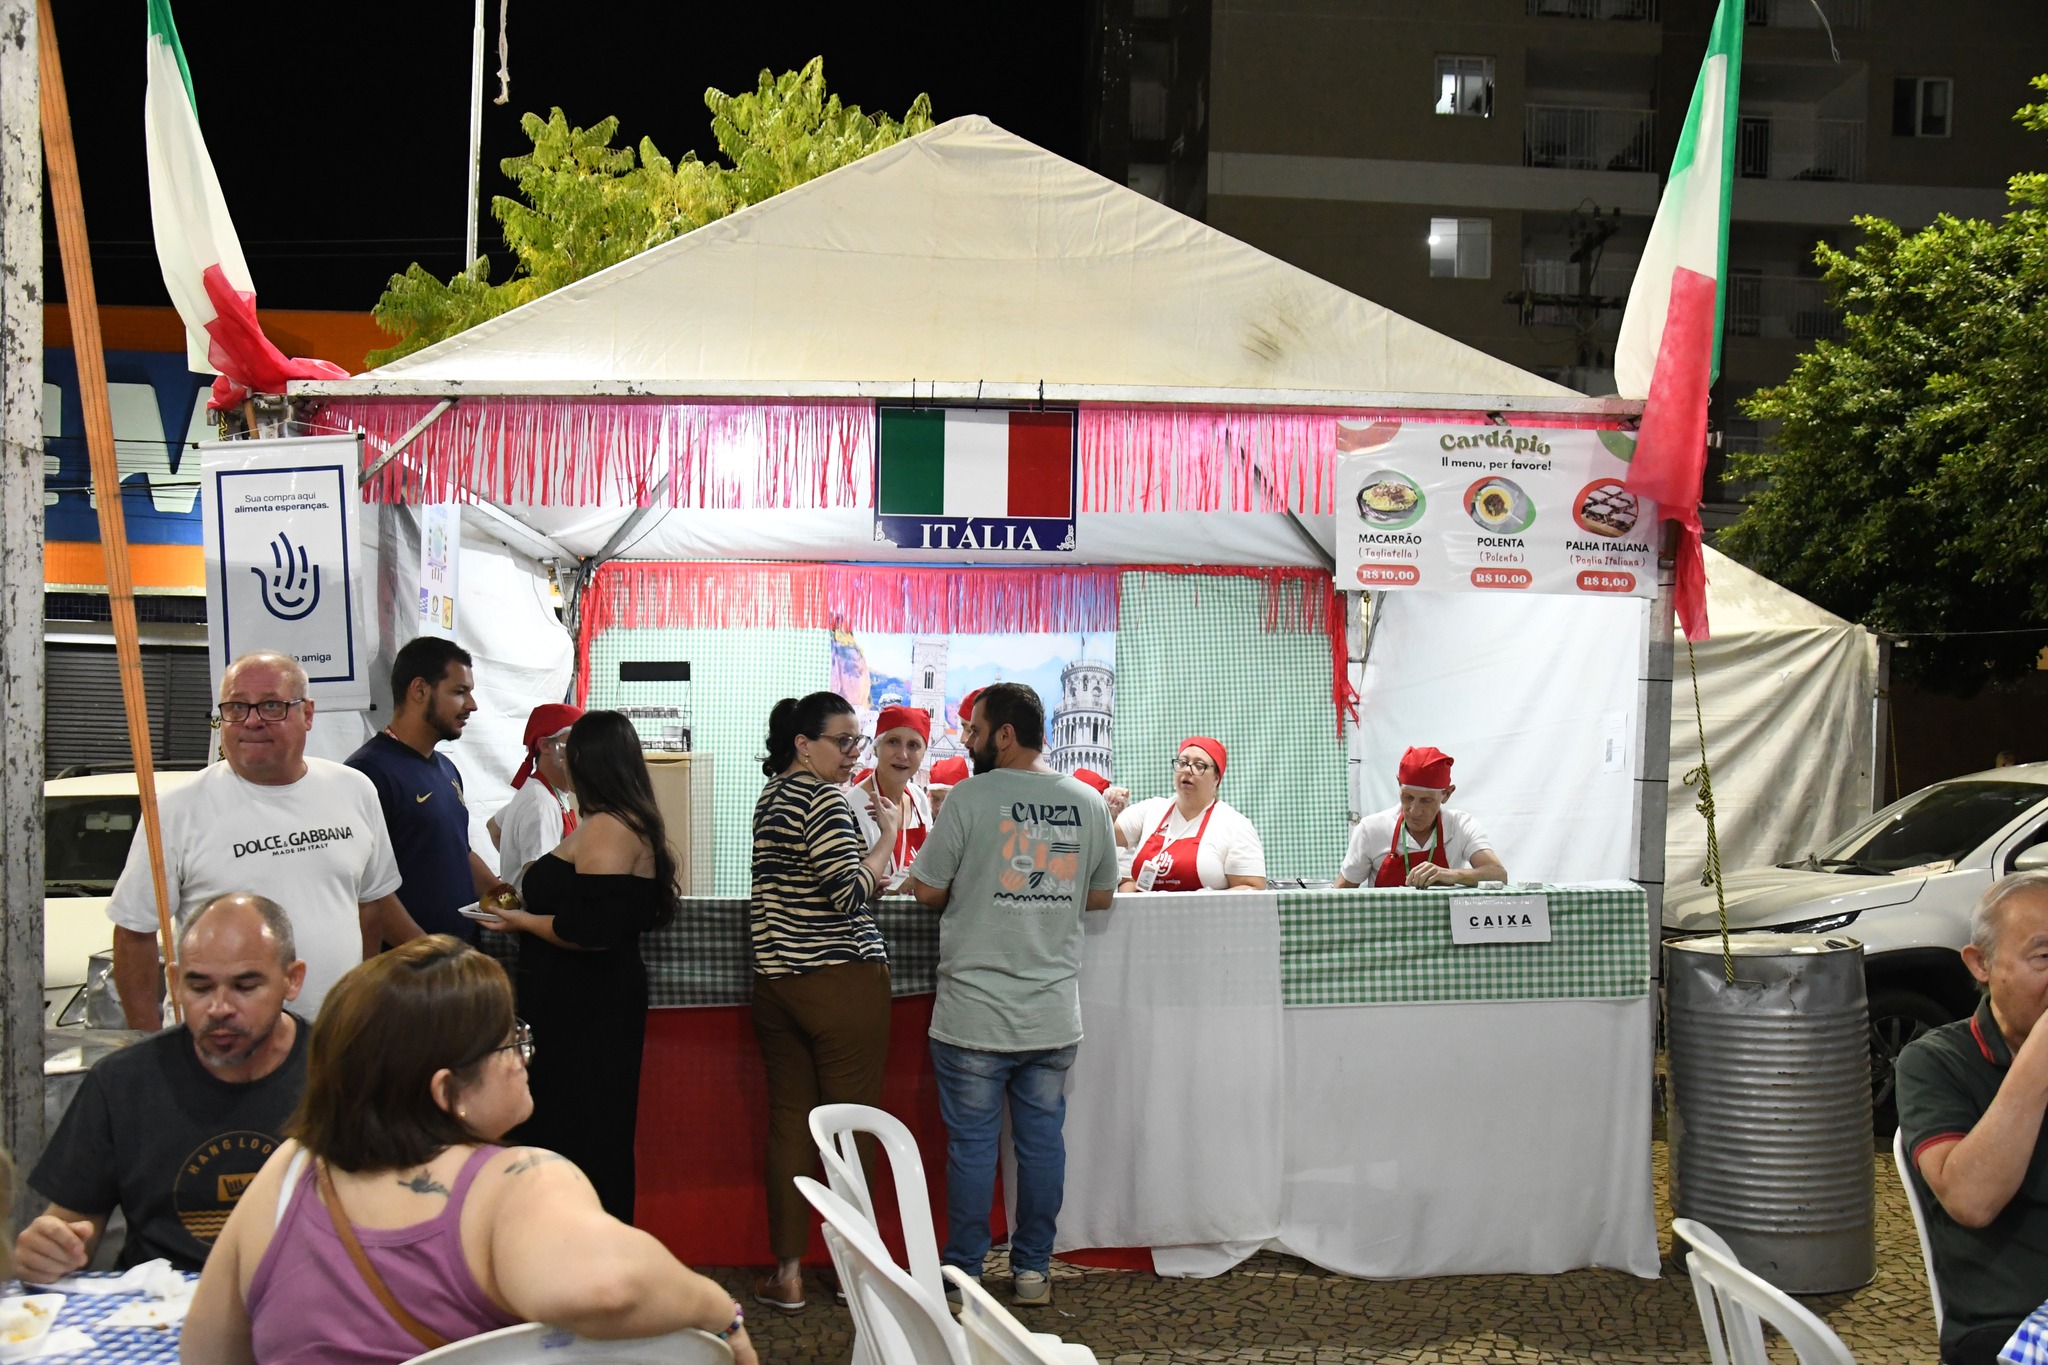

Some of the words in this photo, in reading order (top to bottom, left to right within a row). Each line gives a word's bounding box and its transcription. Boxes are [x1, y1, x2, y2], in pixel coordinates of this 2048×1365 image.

[1440, 429, 1551, 455] Cardápio
[1451, 459, 1486, 470] menu,
[1489, 461, 1508, 471] per
[1511, 459, 1551, 471] favore!
[244, 494, 261, 503] Sua
[263, 493, 296, 502] compra
[297, 492, 316, 501] aqui
[234, 504, 273, 514] alimenta
[275, 502, 329, 512] esperanças.
[920, 517, 1041, 550] ITÁLIA
[1358, 532, 1422, 545] MACARRÃO
[1477, 537, 1525, 548] POLENTA
[1566, 541, 1600, 551] PALHA
[1602, 542, 1649, 553] ITALIANA
[1362, 569, 1379, 580] R$
[1476, 573, 1492, 584] R$
[1494, 574, 1527, 584] 10,00
[1583, 576, 1599, 586] R$
[1601, 577, 1629, 588] 8,00
[301, 652, 331, 664] amiga
[272, 848, 295, 856] MADE
[308, 843, 329, 851] ITALY
[1469, 914, 1531, 927] CAIXA
[188, 1139, 232, 1175] HANG
[239, 1137, 272, 1154] LOO
